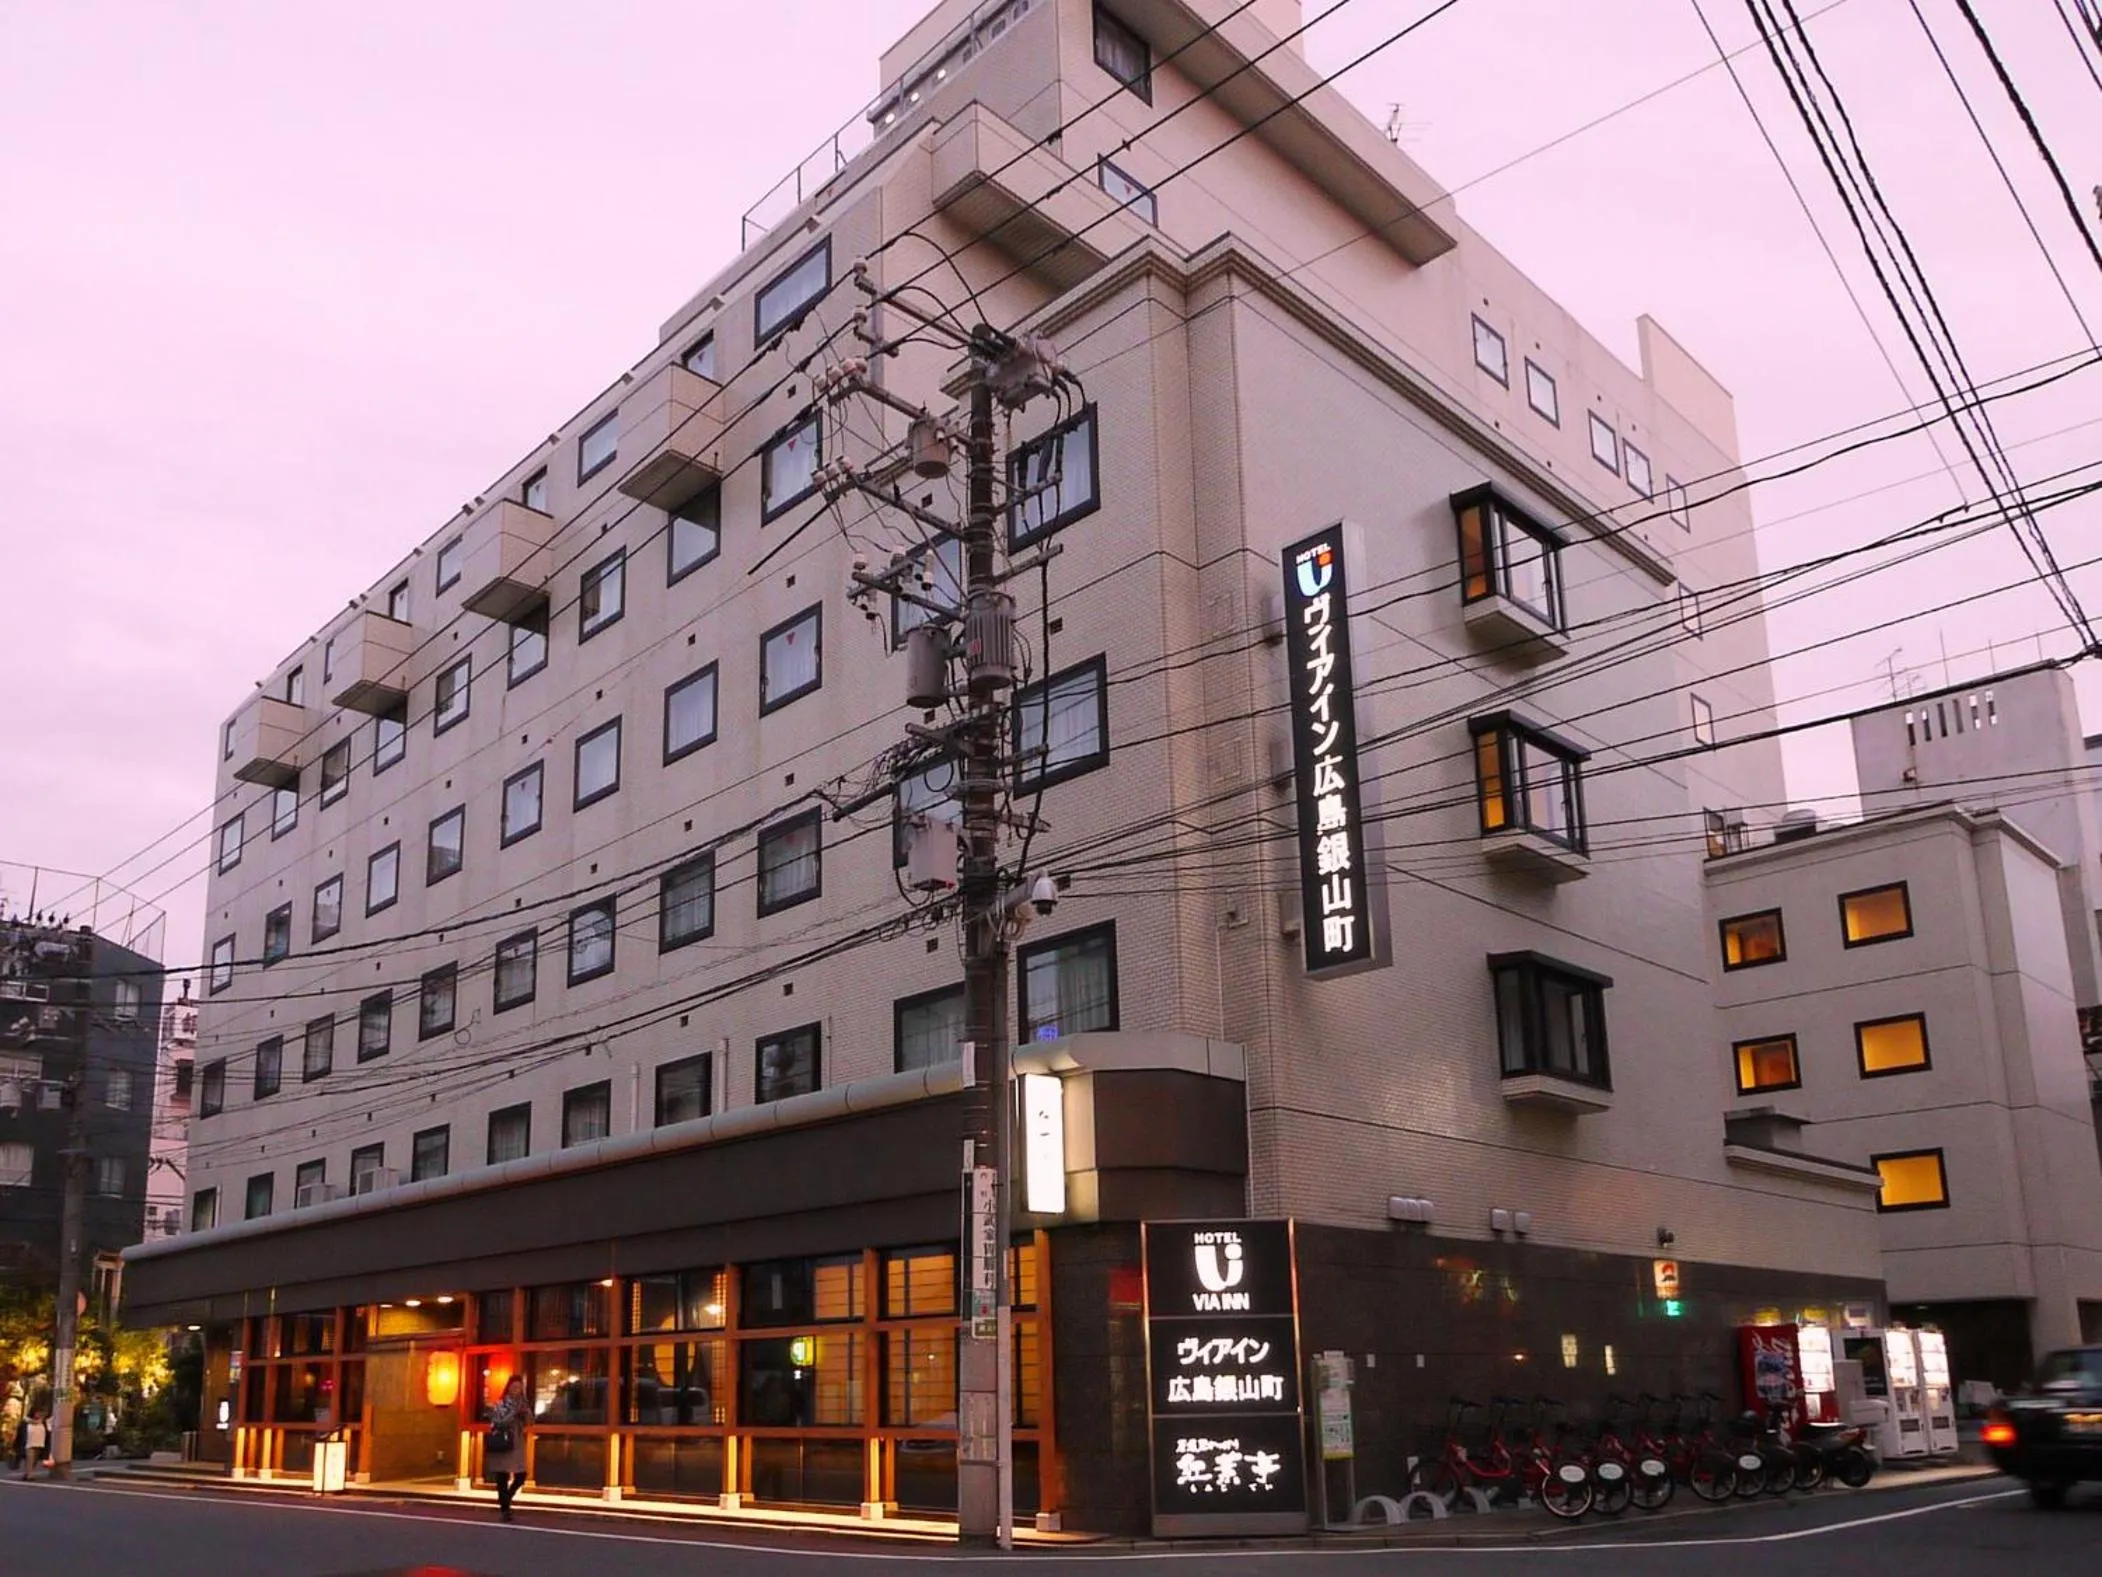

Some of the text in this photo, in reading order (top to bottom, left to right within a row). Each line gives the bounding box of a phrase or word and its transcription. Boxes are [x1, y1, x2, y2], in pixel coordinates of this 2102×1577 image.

[1296, 543, 1332, 564] HOTEL
[1303, 591, 1356, 953] ヴィアイン広島銀山町
[1194, 1231, 1242, 1244] HOTEL
[1192, 1292, 1250, 1311] VIA INN
[1177, 1337, 1270, 1365] ヴィアイン
[1168, 1374, 1284, 1402] 広島銀山町
